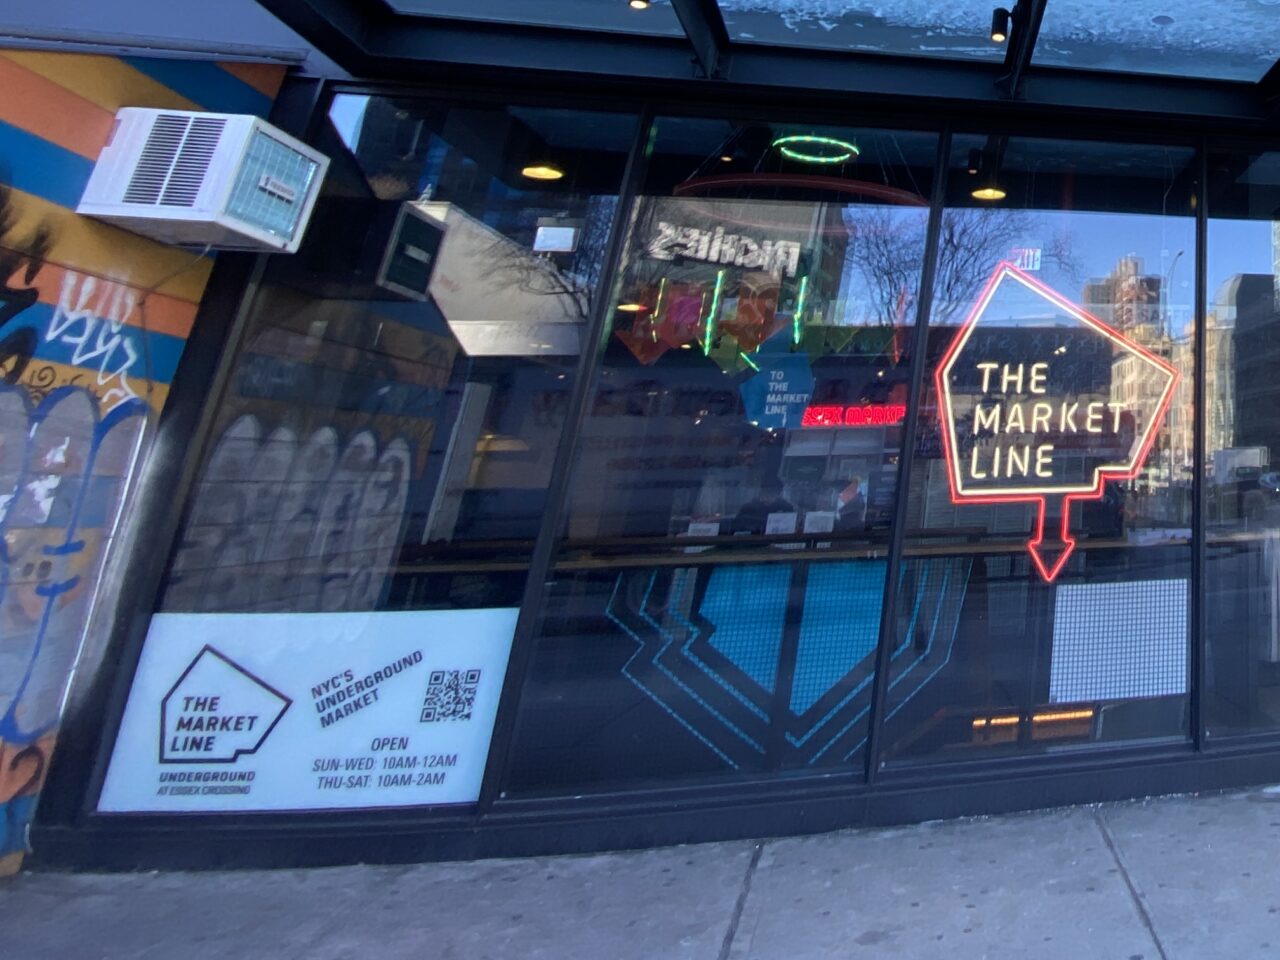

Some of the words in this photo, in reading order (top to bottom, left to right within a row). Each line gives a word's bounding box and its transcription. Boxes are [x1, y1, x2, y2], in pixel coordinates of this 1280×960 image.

[770, 371, 784, 379] TO
[976, 363, 1049, 393] THE
[768, 382, 789, 391] THE
[766, 394, 809, 403] MARKET
[765, 405, 787, 414] LINE
[801, 405, 844, 426] SSEX
[845, 405, 906, 426] MARKE
[973, 403, 1128, 434] MARKET
[970, 445, 1054, 478] LINE
[311, 669, 354, 699] NYC'S
[315, 650, 423, 713] UNDERGROUND
[183, 696, 220, 712] THE
[320, 688, 379, 728] MARKET
[176, 716, 258, 731] MARKET
[170, 736, 216, 752] LINE
[371, 737, 409, 751] OPEN
[383, 754, 457, 769] 10AM-12AM
[159, 771, 256, 782] UNDERGROUND
[378, 772, 445, 787] 10AM-2AM
